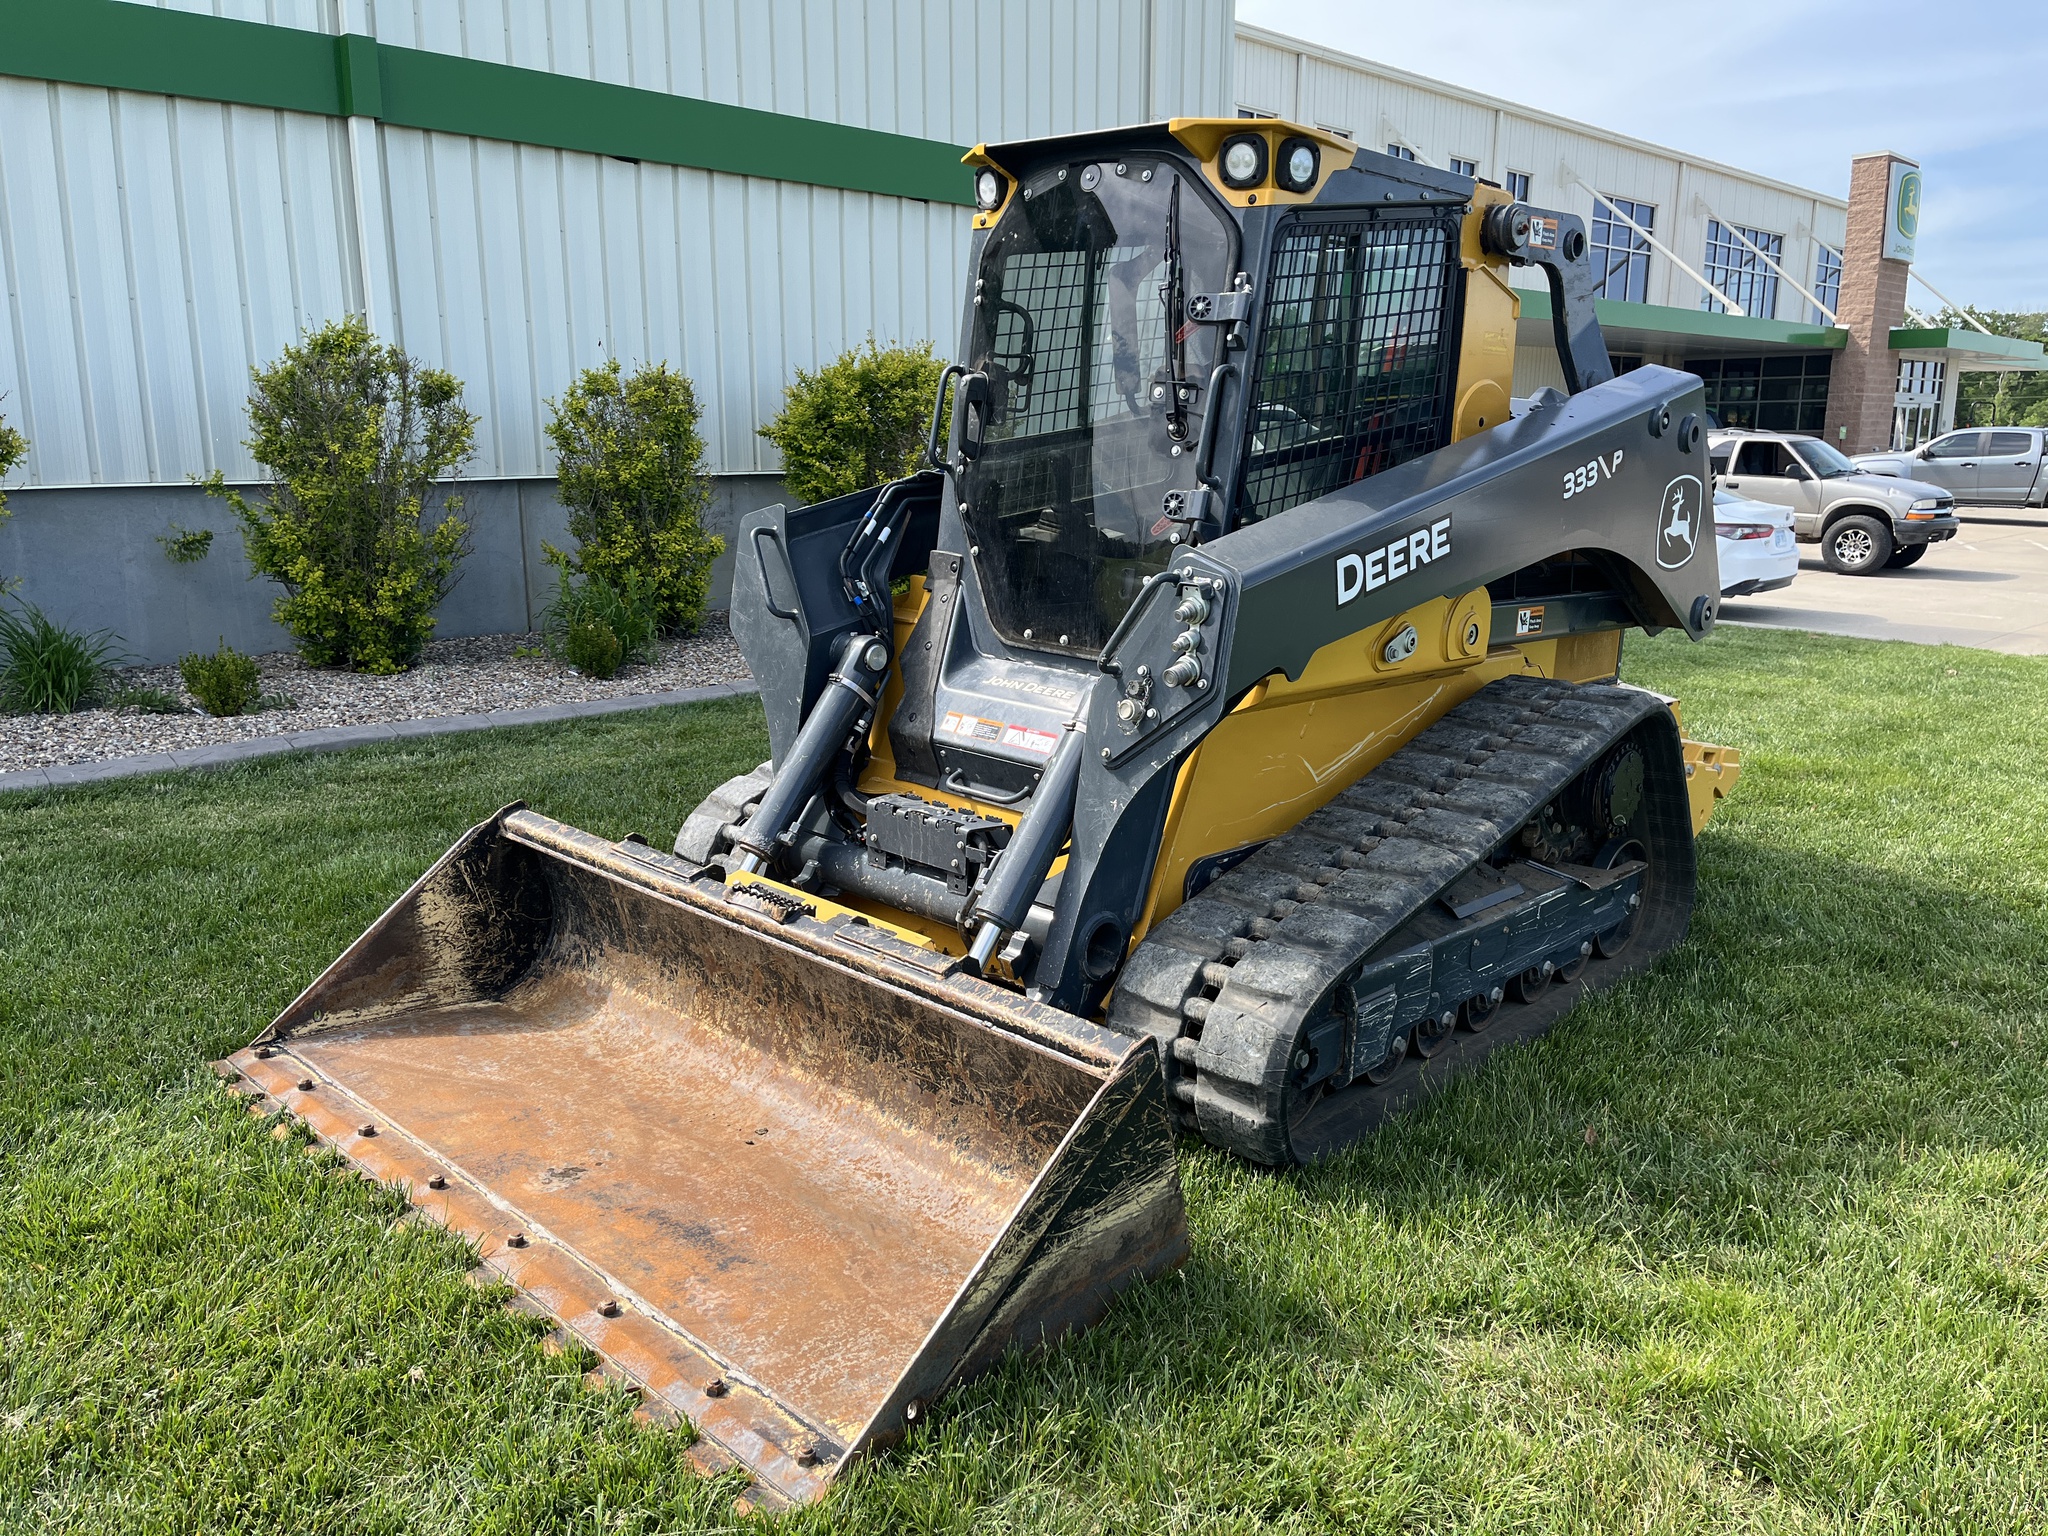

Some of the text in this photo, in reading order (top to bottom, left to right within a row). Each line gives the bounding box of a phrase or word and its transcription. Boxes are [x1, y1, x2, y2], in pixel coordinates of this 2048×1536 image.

[1336, 517, 1451, 606] DEERE
[982, 675, 1076, 699] JOHN DEERE
